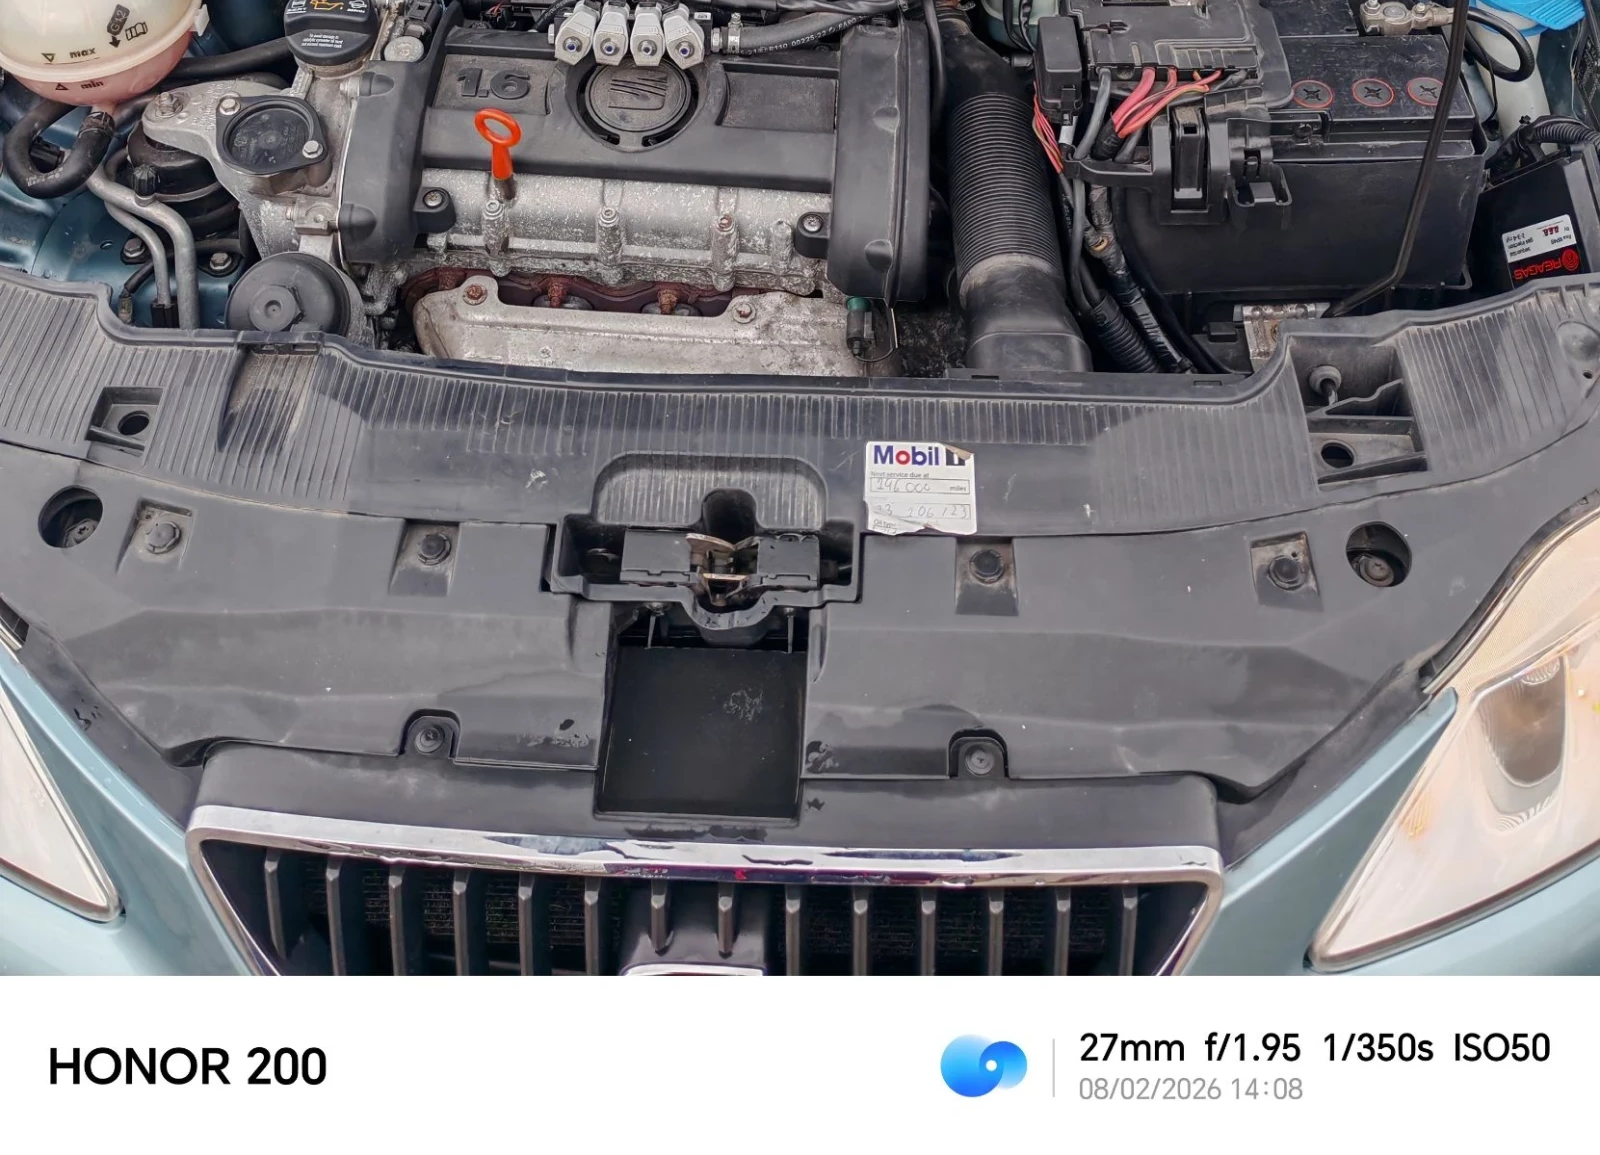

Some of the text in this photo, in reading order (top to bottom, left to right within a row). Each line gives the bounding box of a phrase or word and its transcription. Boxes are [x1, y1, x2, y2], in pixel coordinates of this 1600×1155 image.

[70, 48, 96, 58] max
[80, 80, 104, 90] min
[457, 68, 531, 100] 1.6
[1514, 258, 1562, 280] REAGAS
[874, 445, 940, 466] Mobil
